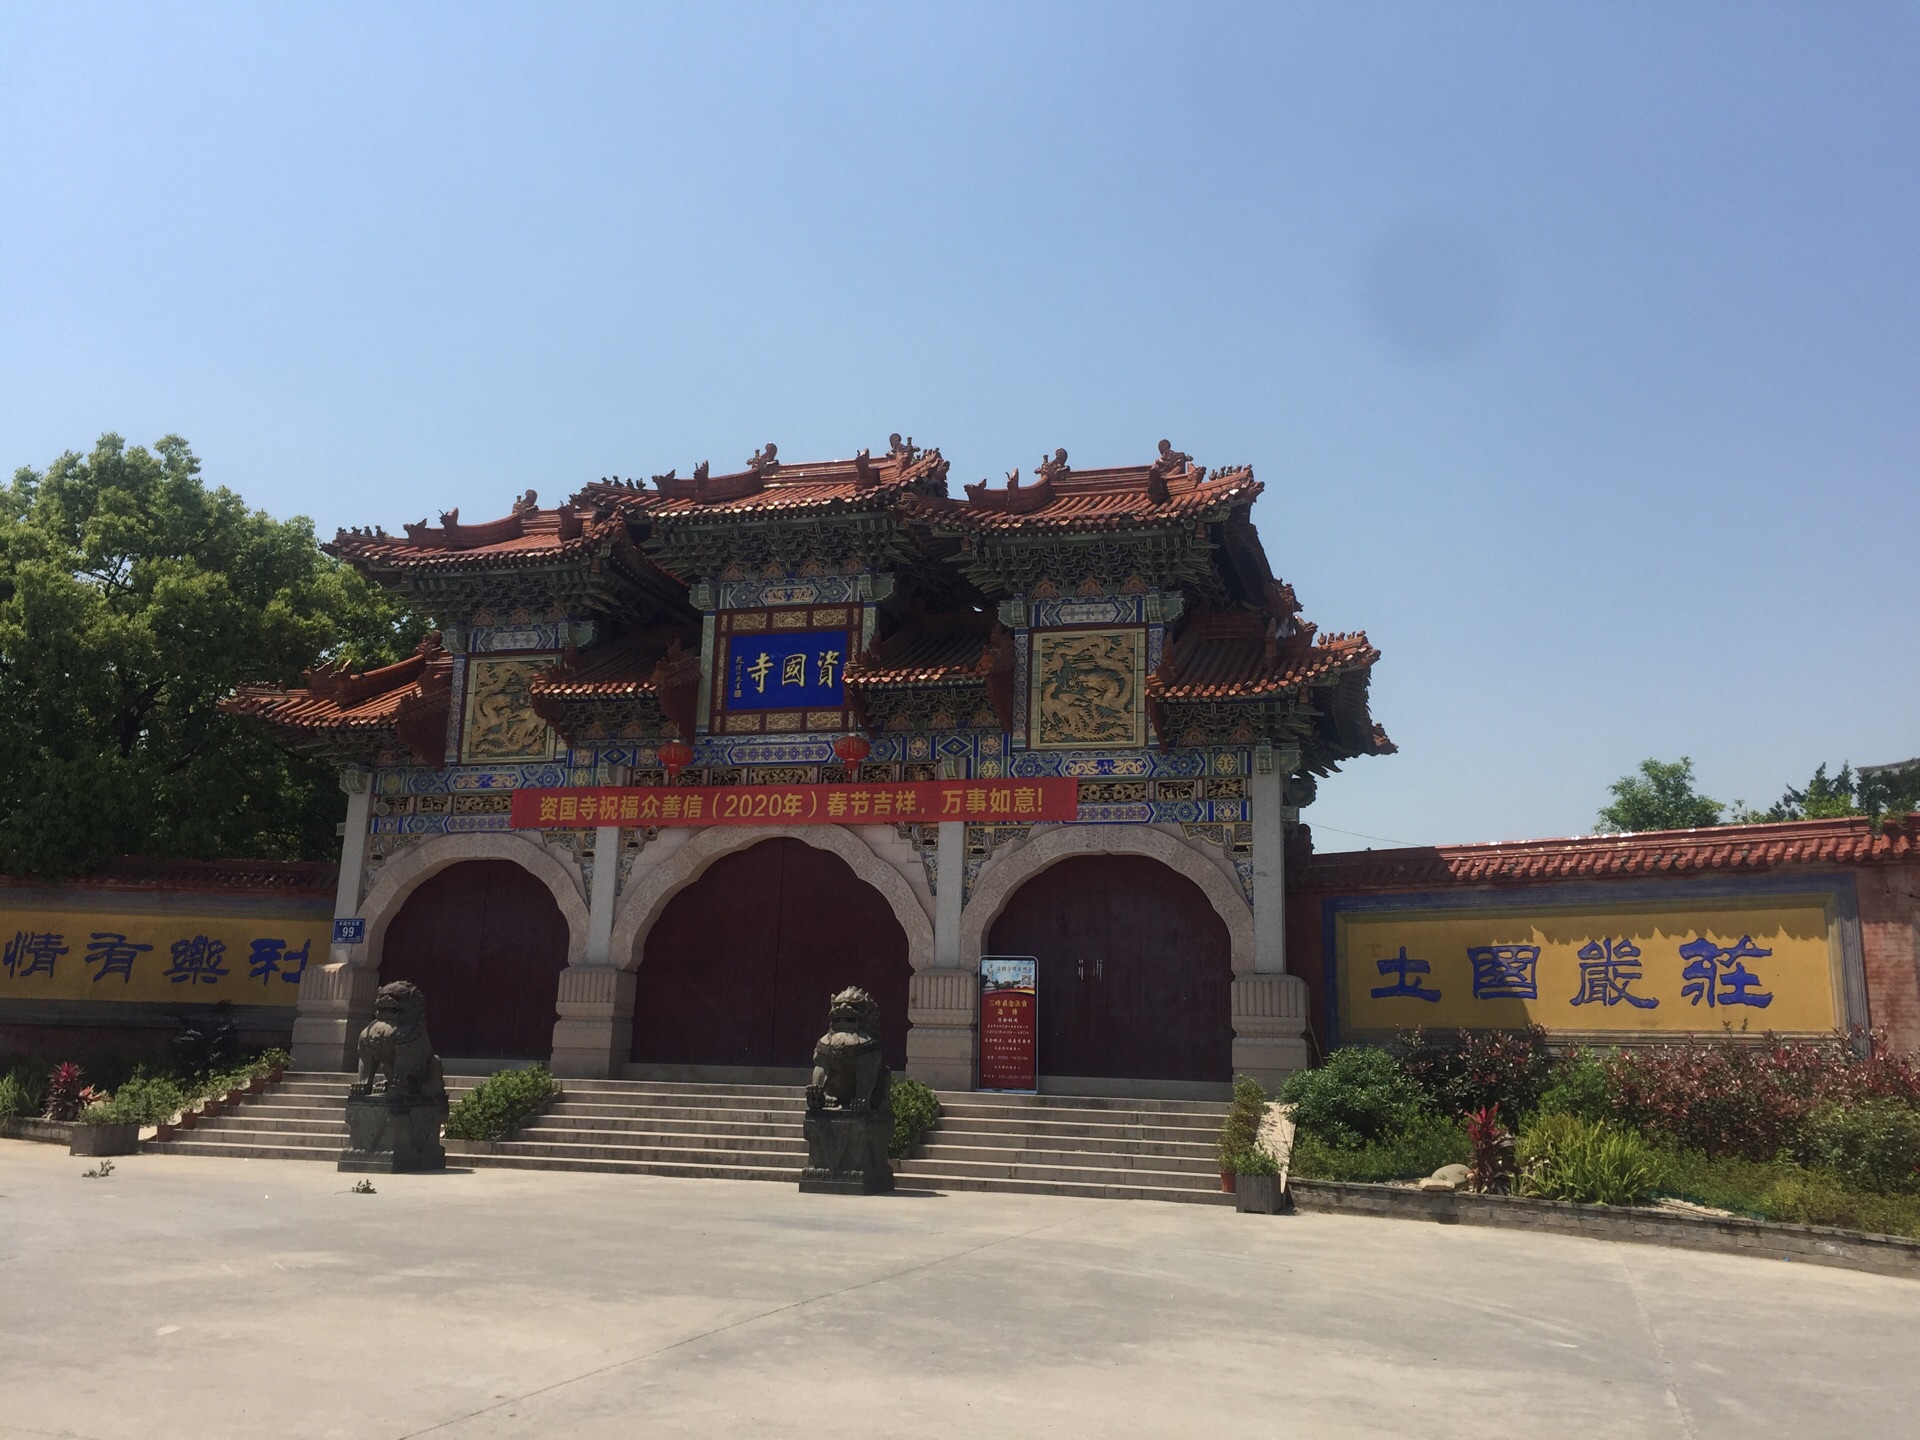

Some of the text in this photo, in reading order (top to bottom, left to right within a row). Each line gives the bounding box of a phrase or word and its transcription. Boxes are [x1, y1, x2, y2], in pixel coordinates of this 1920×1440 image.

[747, 650, 840, 694] 資國寺
[342, 926, 355, 937] 99
